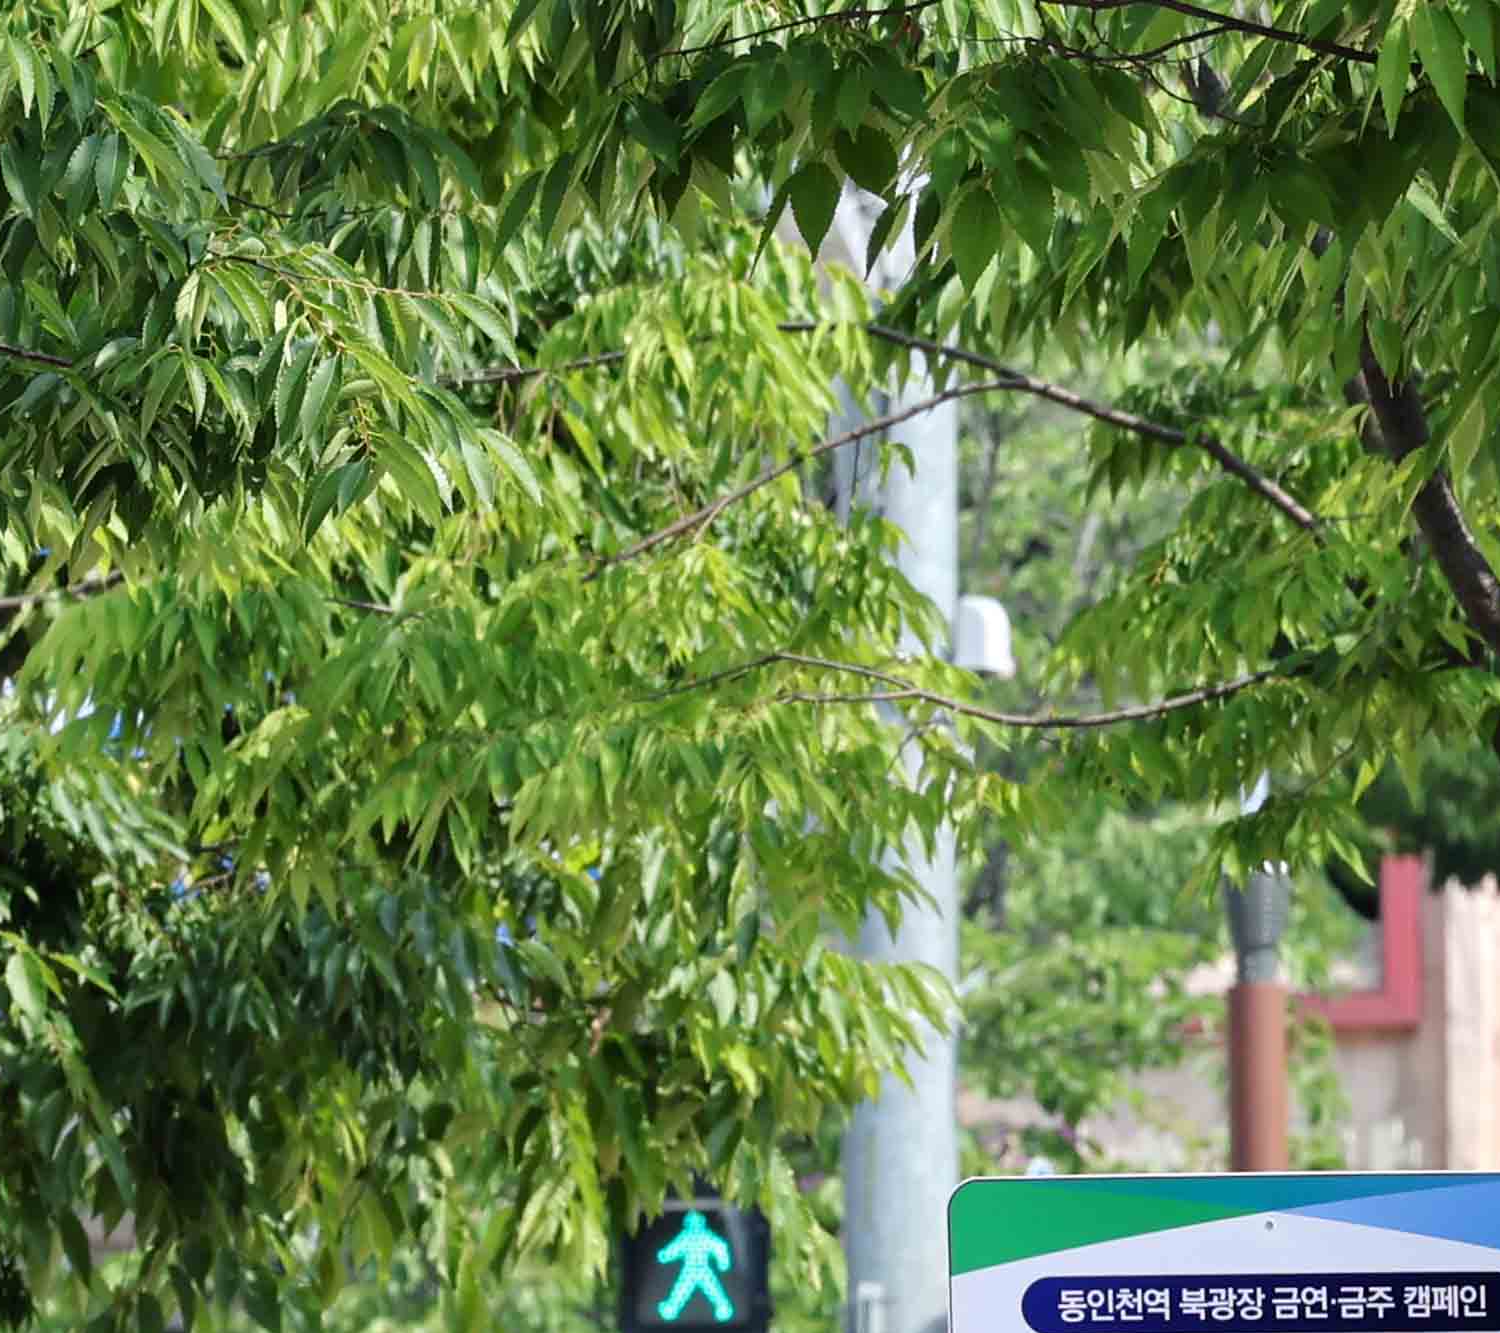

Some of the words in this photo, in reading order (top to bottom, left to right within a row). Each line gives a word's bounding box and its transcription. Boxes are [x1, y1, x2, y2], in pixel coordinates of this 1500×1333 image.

[1057, 1287, 1170, 1322] 동인천역
[1179, 1287, 1265, 1321] 북광장
[1272, 1286, 1395, 1321] 금연·금주
[1403, 1283, 1488, 1320] 캠페인
